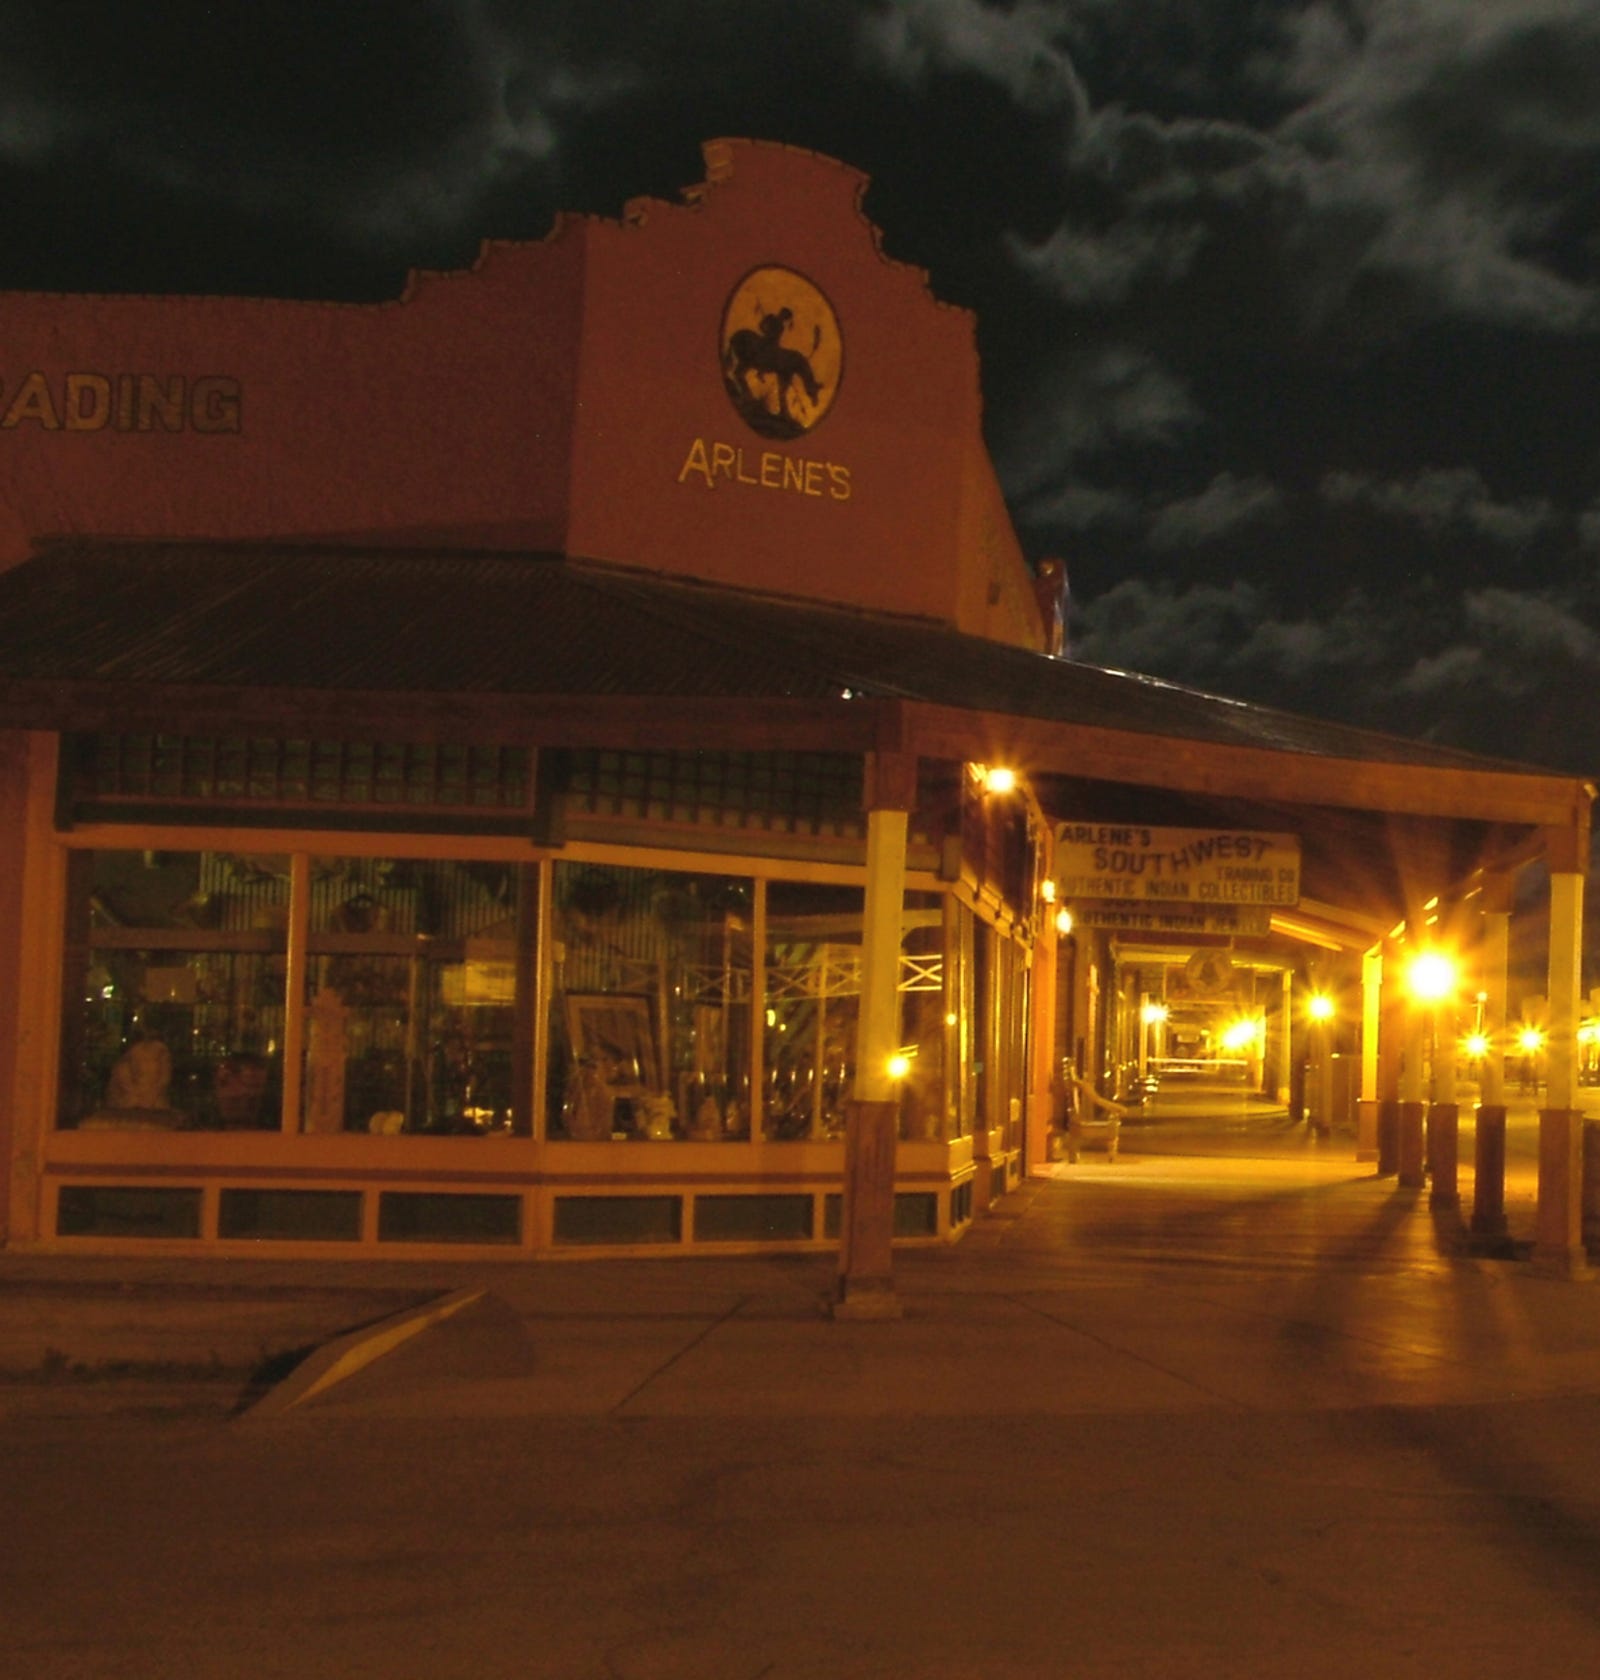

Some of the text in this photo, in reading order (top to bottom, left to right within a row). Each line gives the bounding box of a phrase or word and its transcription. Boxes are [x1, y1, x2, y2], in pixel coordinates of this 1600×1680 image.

[0, 370, 242, 434] ADING
[677, 437, 851, 500] ARLENE'S
[1059, 825, 1151, 847] ARLENE'S
[1093, 834, 1272, 875] SOUTHWEST
[1215, 866, 1273, 882] TRADING
[1145, 879, 1190, 898] INDIAN
[1198, 881, 1295, 902] COLLECTIBLES
[1081, 911, 1152, 928] UTHENTIC
